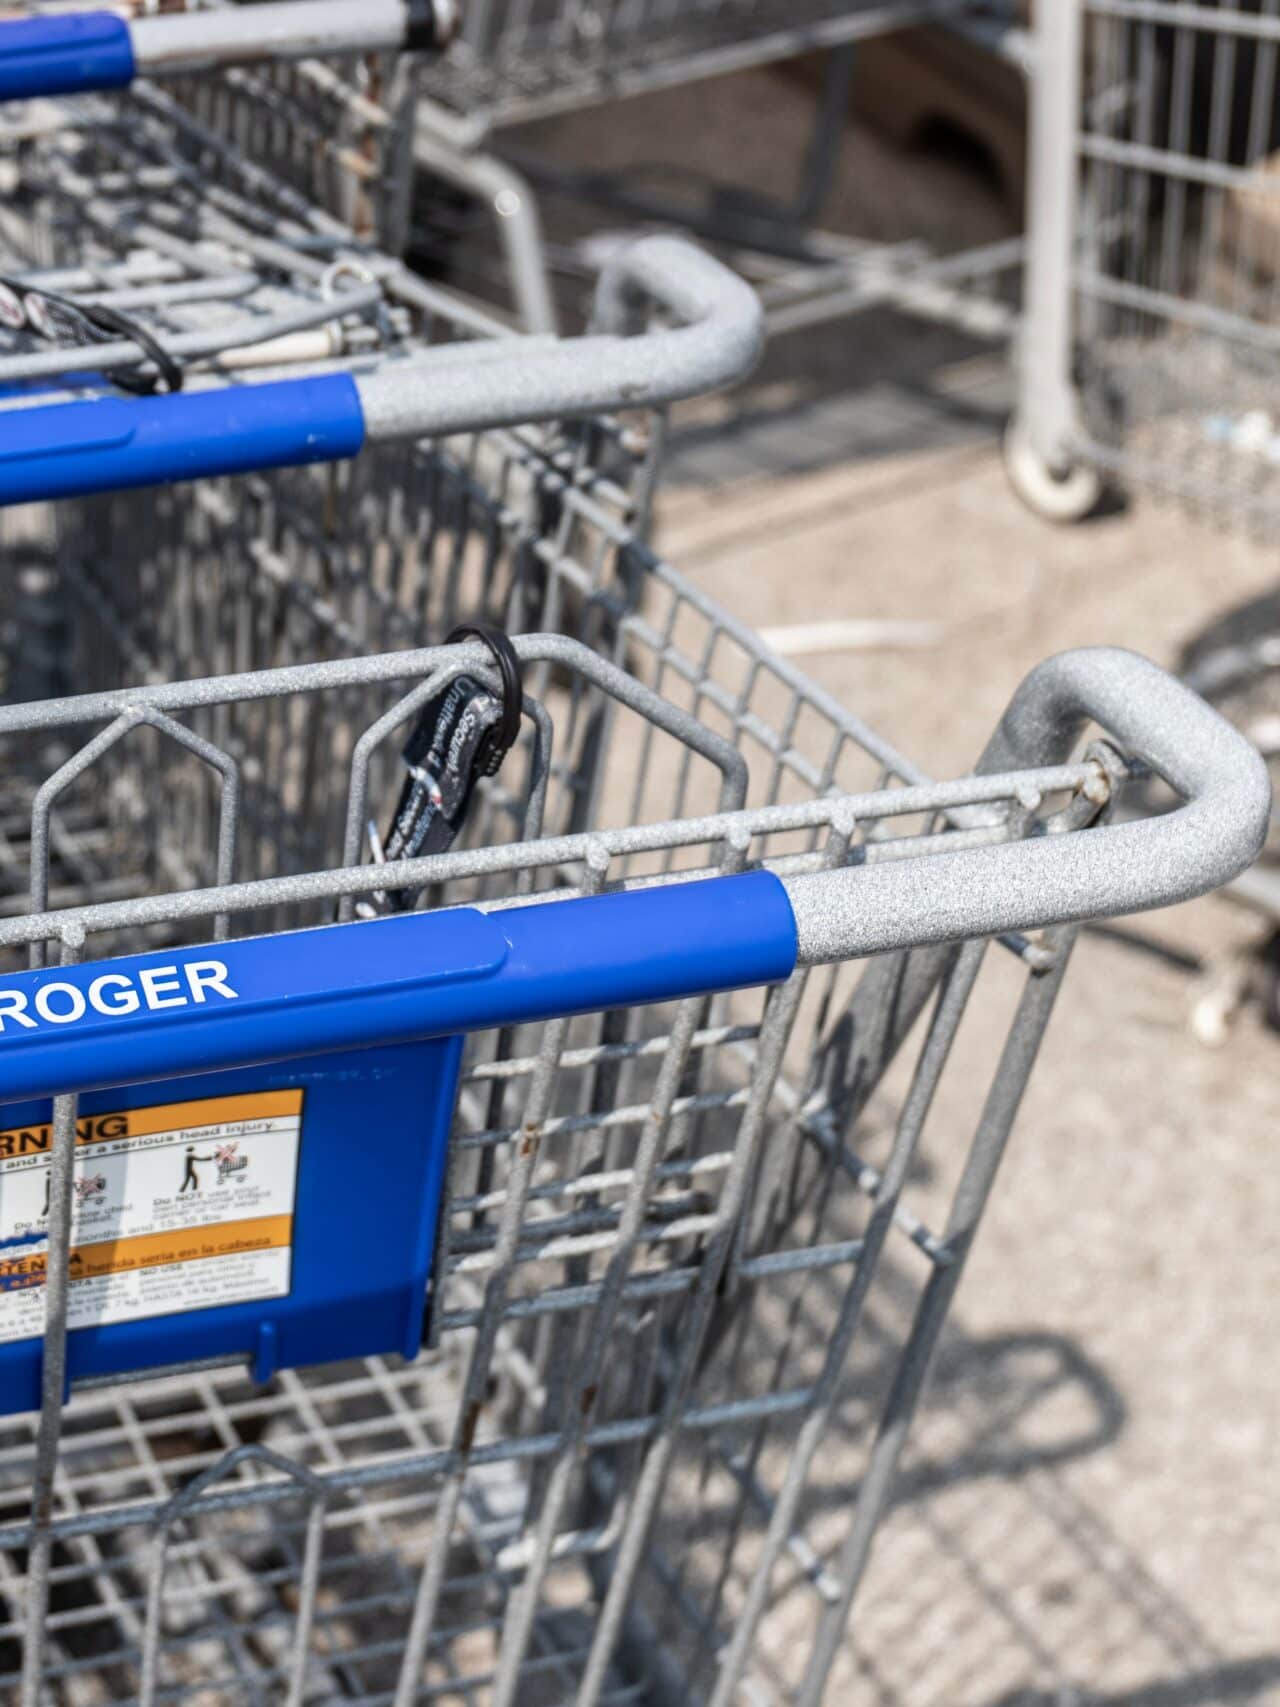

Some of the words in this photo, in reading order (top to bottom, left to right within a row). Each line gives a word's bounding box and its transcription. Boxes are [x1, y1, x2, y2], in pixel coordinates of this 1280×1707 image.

[6, 1154, 38, 1170] and
[111, 1134, 175, 1151] serious
[180, 1126, 221, 1140] head
[218, 1237, 272, 1252] cabeza
